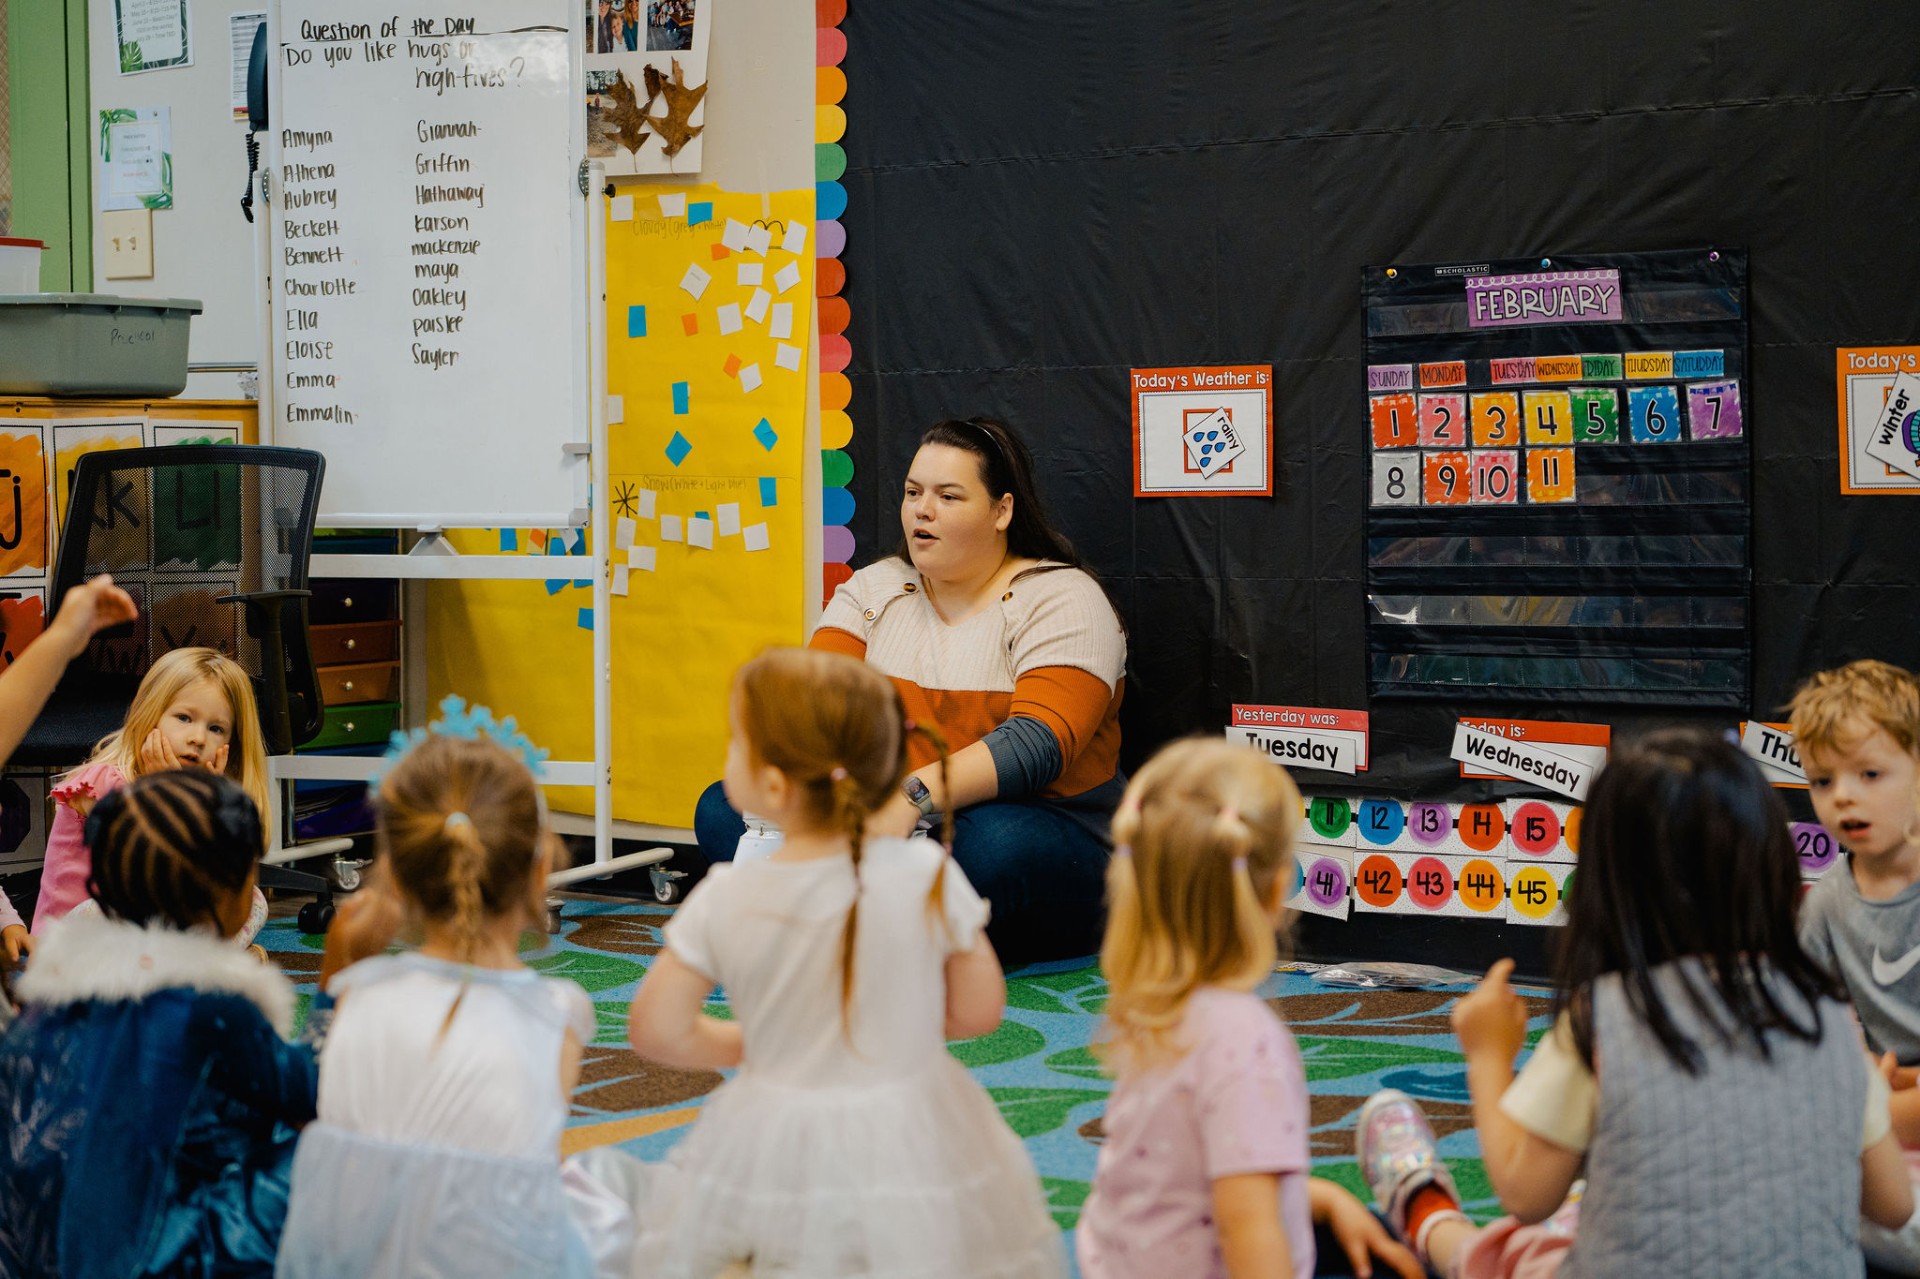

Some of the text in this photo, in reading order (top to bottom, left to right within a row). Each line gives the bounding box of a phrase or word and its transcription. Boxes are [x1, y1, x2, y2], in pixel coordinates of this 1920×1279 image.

[301, 16, 475, 41] Question of the Day
[286, 48, 312, 67] Do
[325, 46, 352, 68] you
[365, 42, 397, 62] like
[408, 39, 450, 66] hugs
[283, 163, 335, 183] Athena
[415, 153, 470, 175] Griffin
[284, 188, 337, 210] Aubrey
[415, 184, 485, 209] Hathaway
[284, 220, 341, 239] Beckett
[284, 246, 345, 266] Bennett
[1442, 265, 1489, 275] SCHOLASTIC
[284, 278, 357, 297] Charlotte
[412, 288, 467, 311] Oakley
[1474, 283, 1617, 321] FEBRUARY
[286, 309, 319, 331] Ella
[286, 341, 334, 360] Eloise
[411, 342, 460, 371] Sayler
[1847, 351, 1917, 371] Today's
[286, 372, 337, 390] Emma
[1133, 370, 1270, 391] Today's Weather is:
[1370, 370, 1410, 388] SUNDAY
[1421, 365, 1464, 384] MONDAY
[1492, 361, 1536, 380] TUESDAY
[1537, 362, 1581, 376] WEDNESDAY
[1627, 357, 1672, 373] THURSDAY
[1674, 355, 1725, 372] SATURDAY
[286, 403, 354, 425] Emmalin
[1390, 396, 1723, 440] 1 2 3 4 5 6 7
[1217, 416, 1240, 450] rainy
[1386, 457, 1559, 500] 8 9 10 11
[1236, 707, 1339, 726] Yesterday was:
[1510, 723, 1526, 738] is:
[1246, 732, 1339, 769] Tuesday
[1466, 734, 1581, 793] Wednesday
[1326, 802, 1830, 859] 11 12 13 14 15 20
[1316, 870, 1547, 905] 41 42 43 44 45
